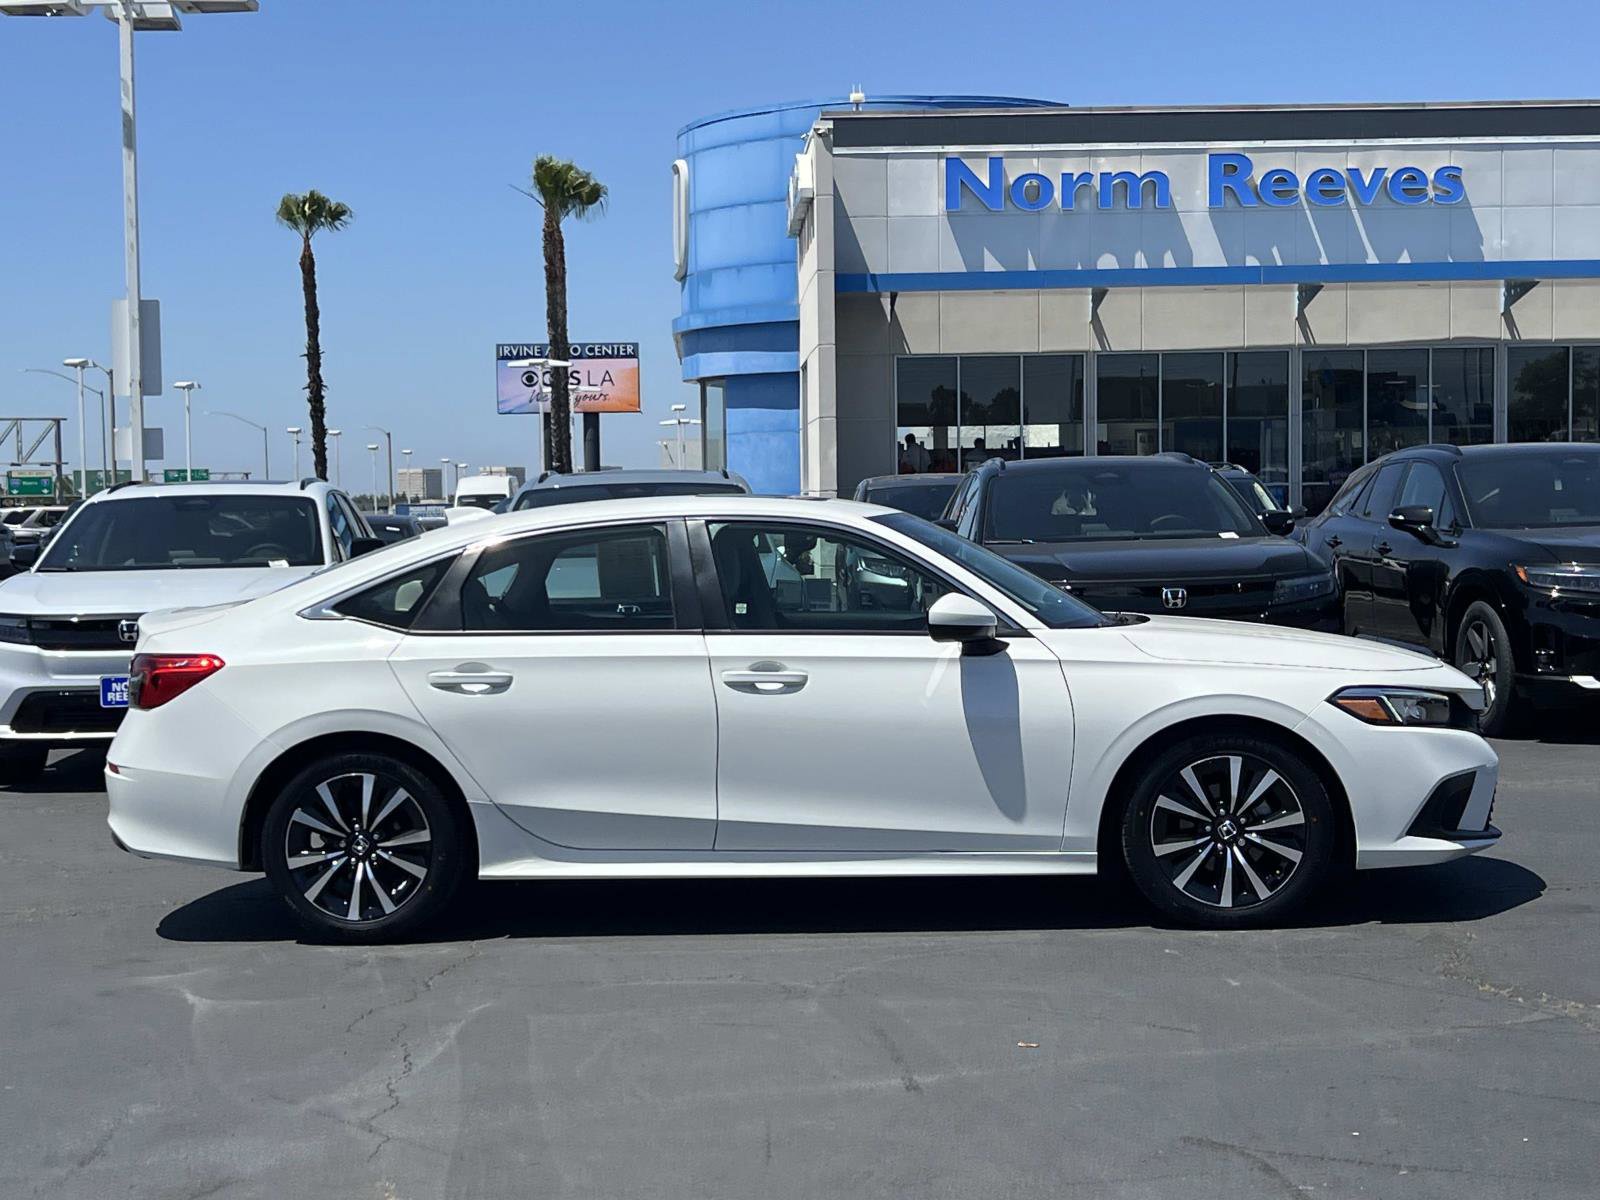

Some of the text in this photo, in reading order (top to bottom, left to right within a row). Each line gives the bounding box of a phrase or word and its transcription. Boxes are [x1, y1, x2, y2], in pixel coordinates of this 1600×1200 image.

[945, 153, 1465, 212] Norm Reeves
[499, 345, 541, 357] IRVINE
[585, 345, 634, 356] CENTER
[542, 370, 615, 386] CS LA
